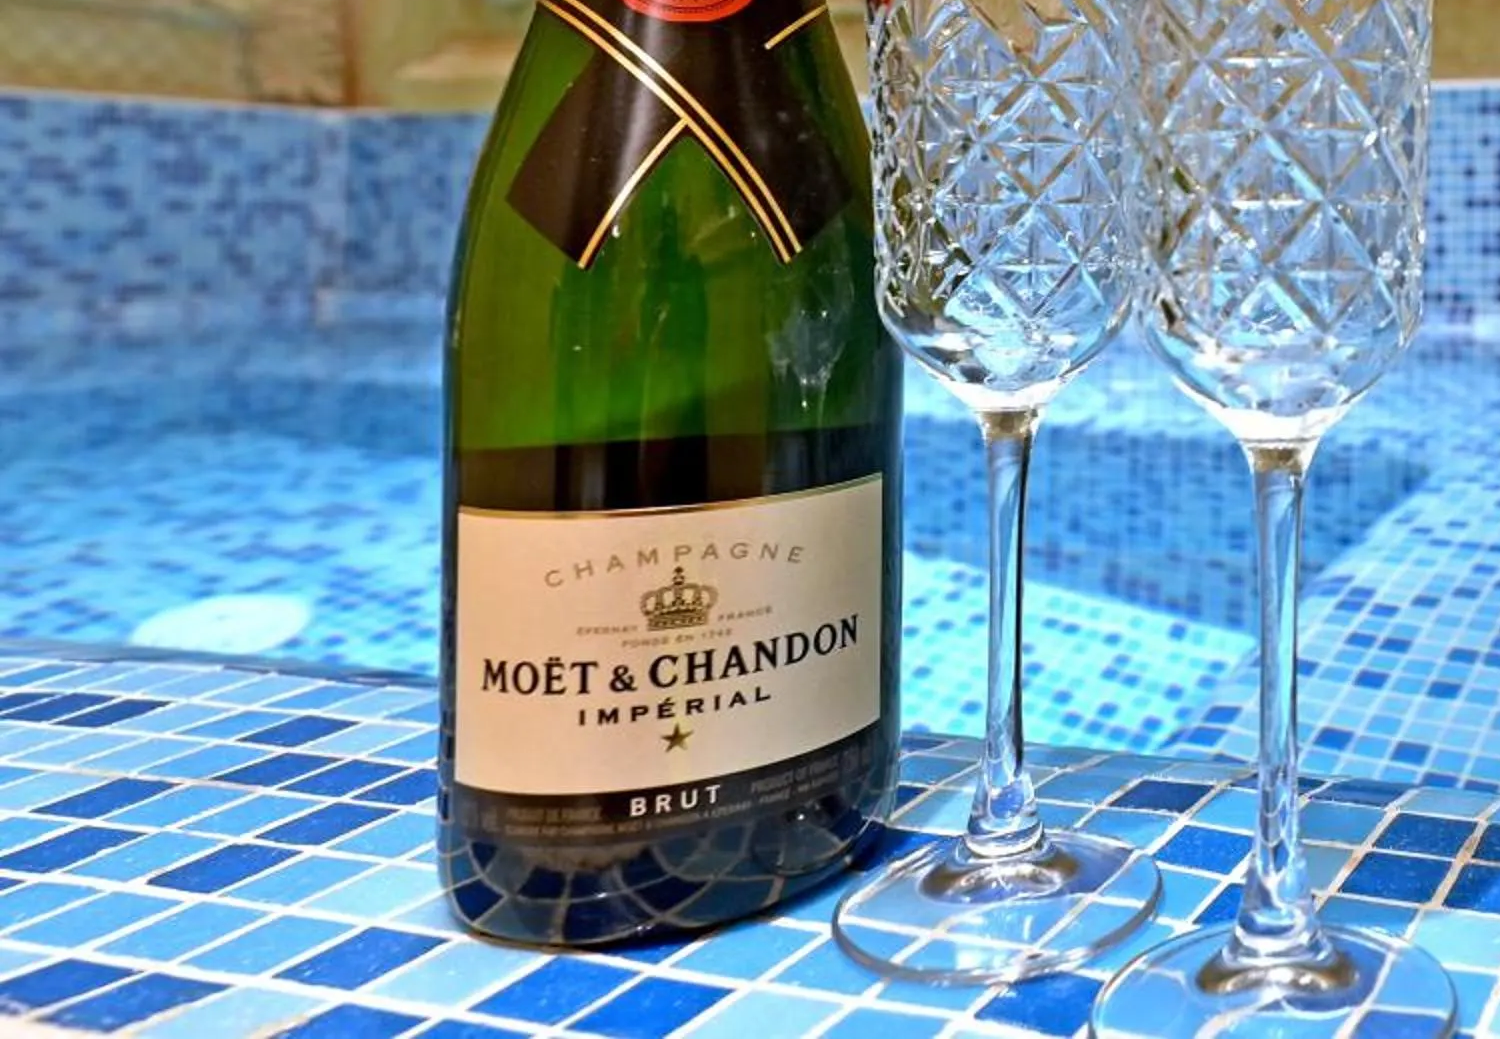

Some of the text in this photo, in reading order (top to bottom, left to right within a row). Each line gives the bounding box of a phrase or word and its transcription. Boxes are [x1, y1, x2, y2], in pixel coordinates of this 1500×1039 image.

[543, 540, 807, 589] CHAMPAGNE
[480, 613, 861, 696] MOËT & CHANDON
[577, 685, 772, 727] IMPÉRIAL
[629, 783, 722, 819] BRUT
